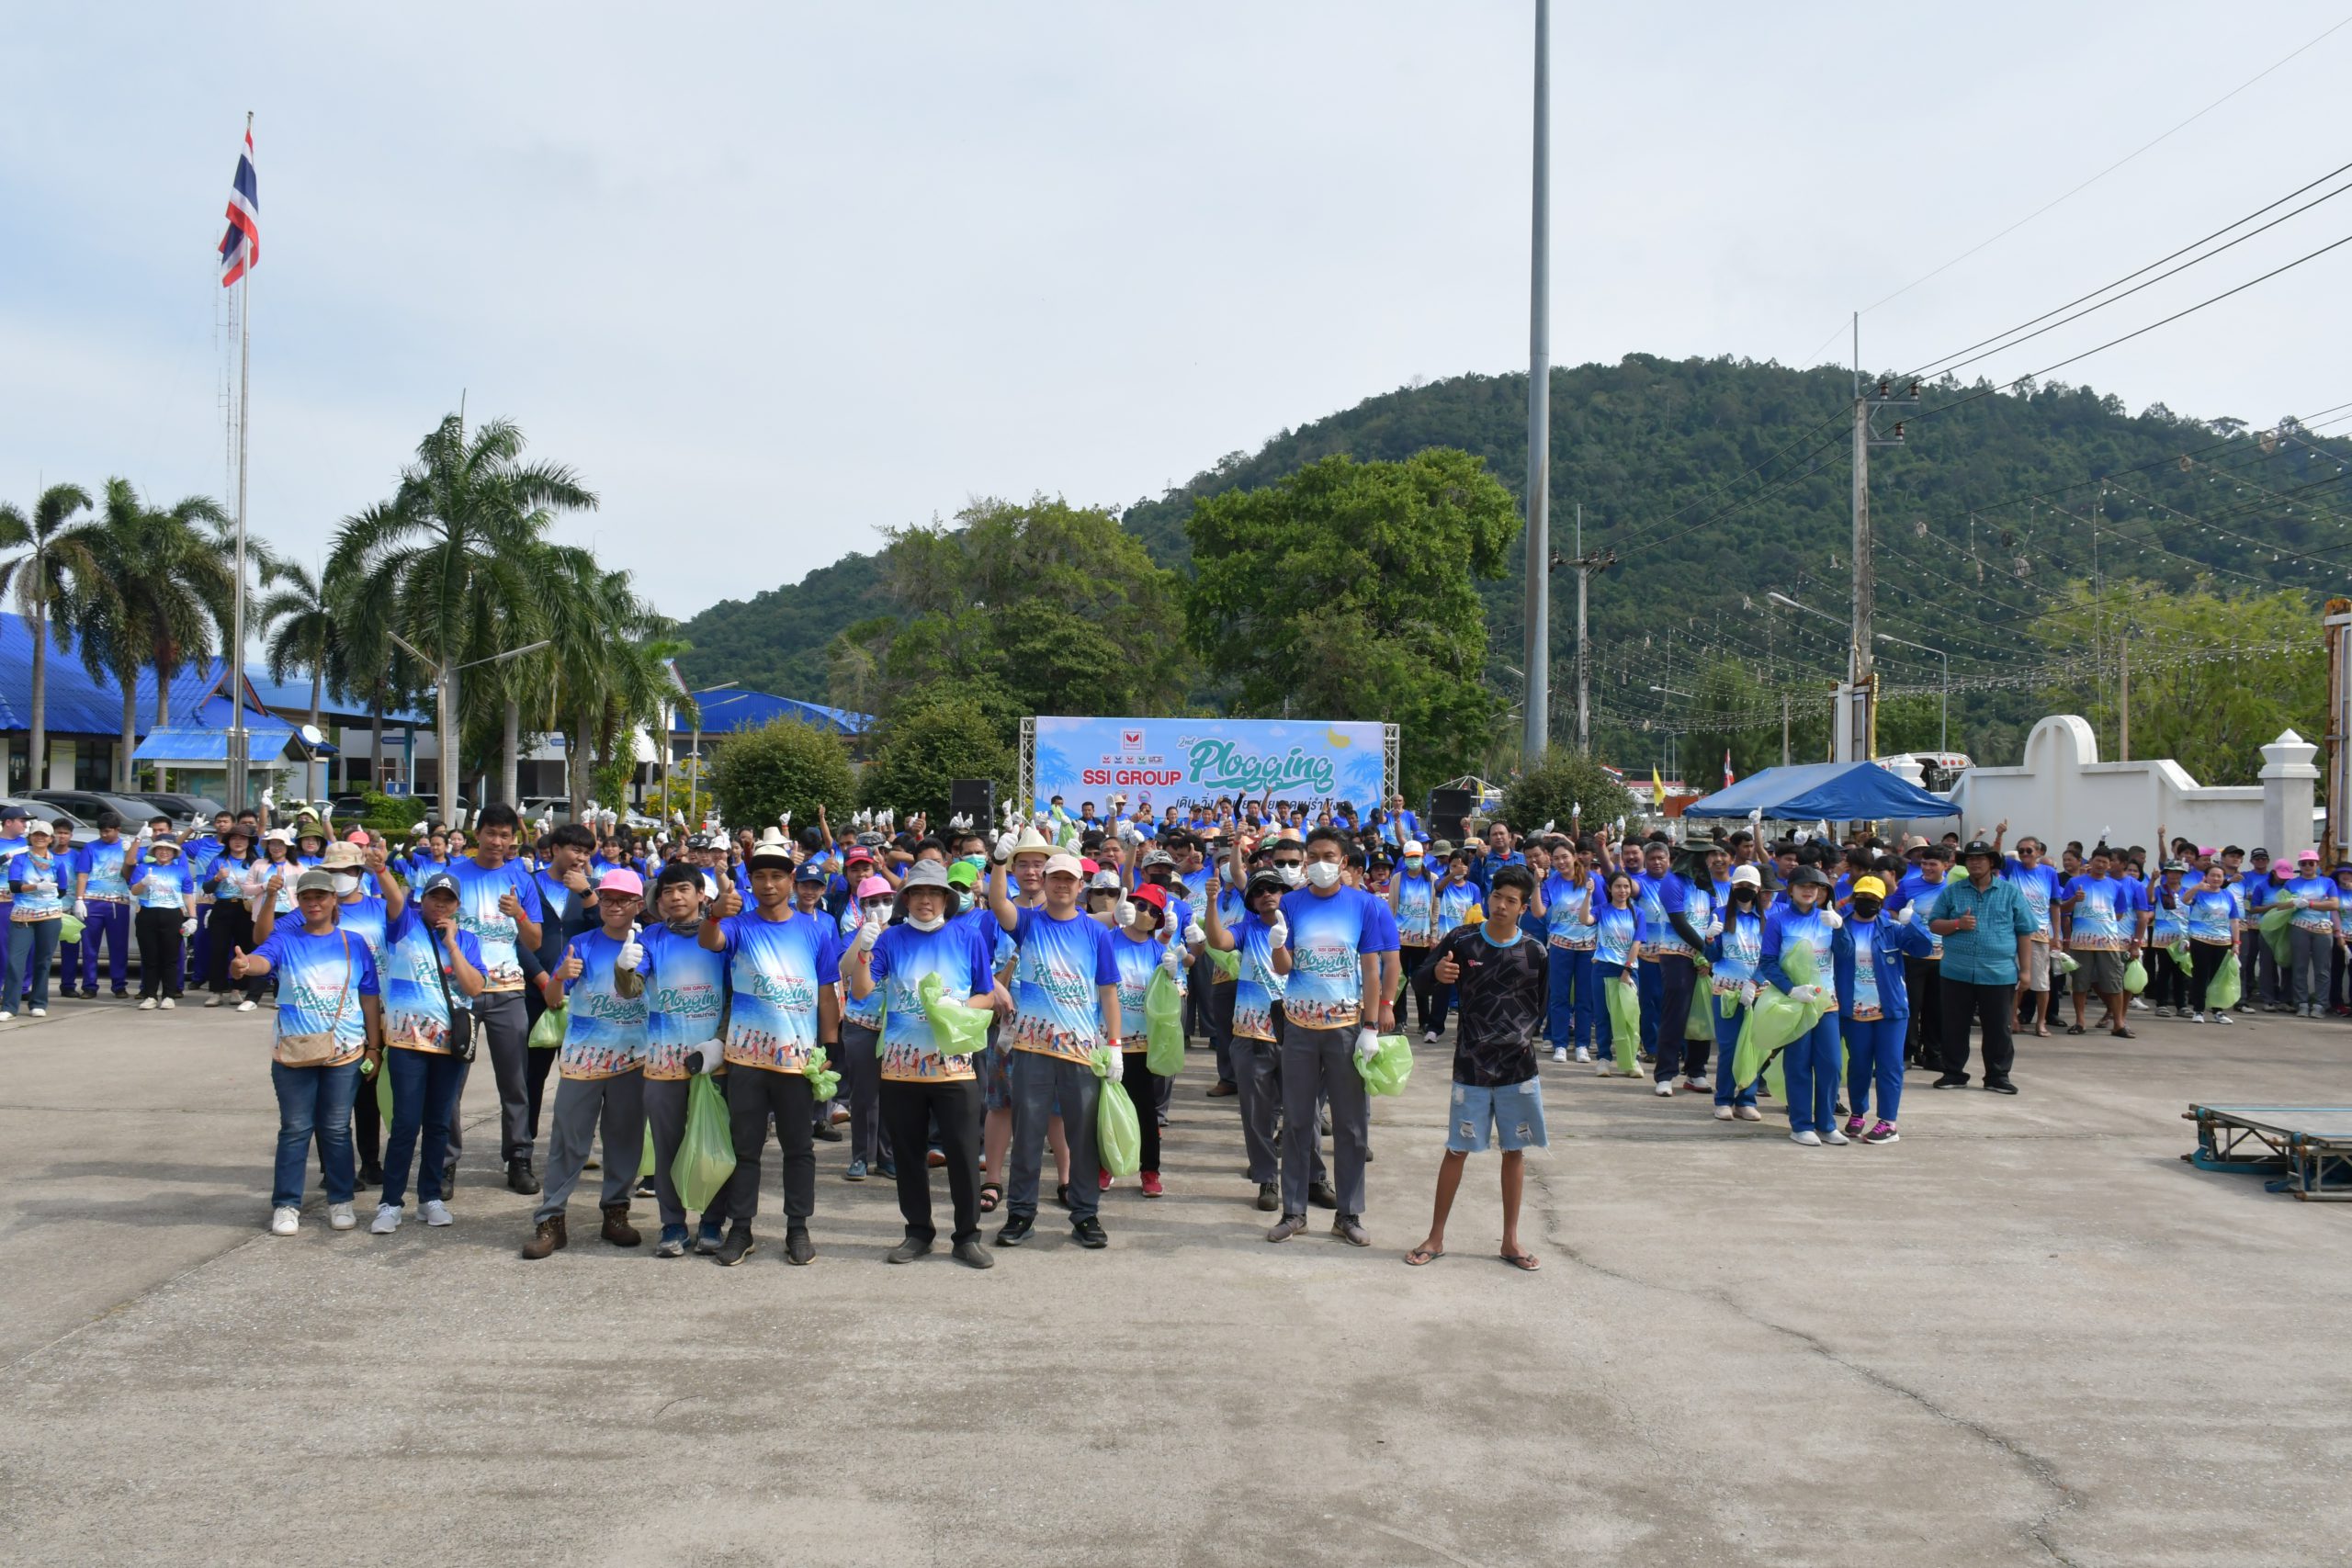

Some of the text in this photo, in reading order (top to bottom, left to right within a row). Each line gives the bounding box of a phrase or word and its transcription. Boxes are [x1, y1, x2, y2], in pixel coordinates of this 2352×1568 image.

[1178, 737, 1196, 748] 2nd
[1083, 770, 1182, 786] SSI GROUP
[1189, 739, 1335, 794] Plogging
[658, 988, 720, 1013] Plogging
[752, 974, 814, 1008] Plogging
